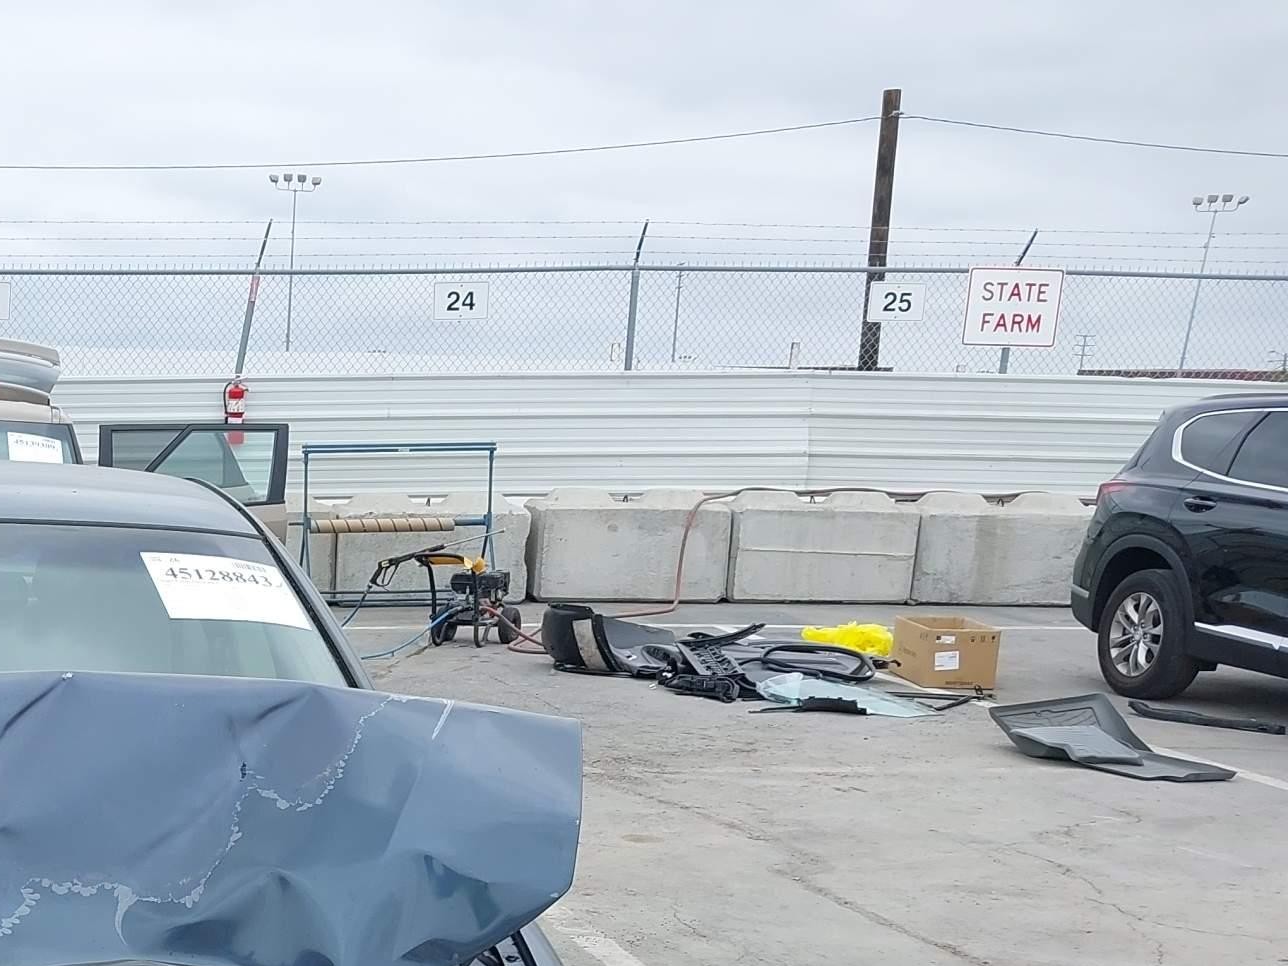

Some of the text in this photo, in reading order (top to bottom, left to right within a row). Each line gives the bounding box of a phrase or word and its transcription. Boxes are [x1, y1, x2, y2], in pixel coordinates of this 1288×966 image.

[446, 291, 476, 311] 24
[882, 291, 912, 313] 25
[982, 281, 1050, 303] STATE
[980, 312, 1042, 334] FARM
[165, 566, 273, 588] 45128843
